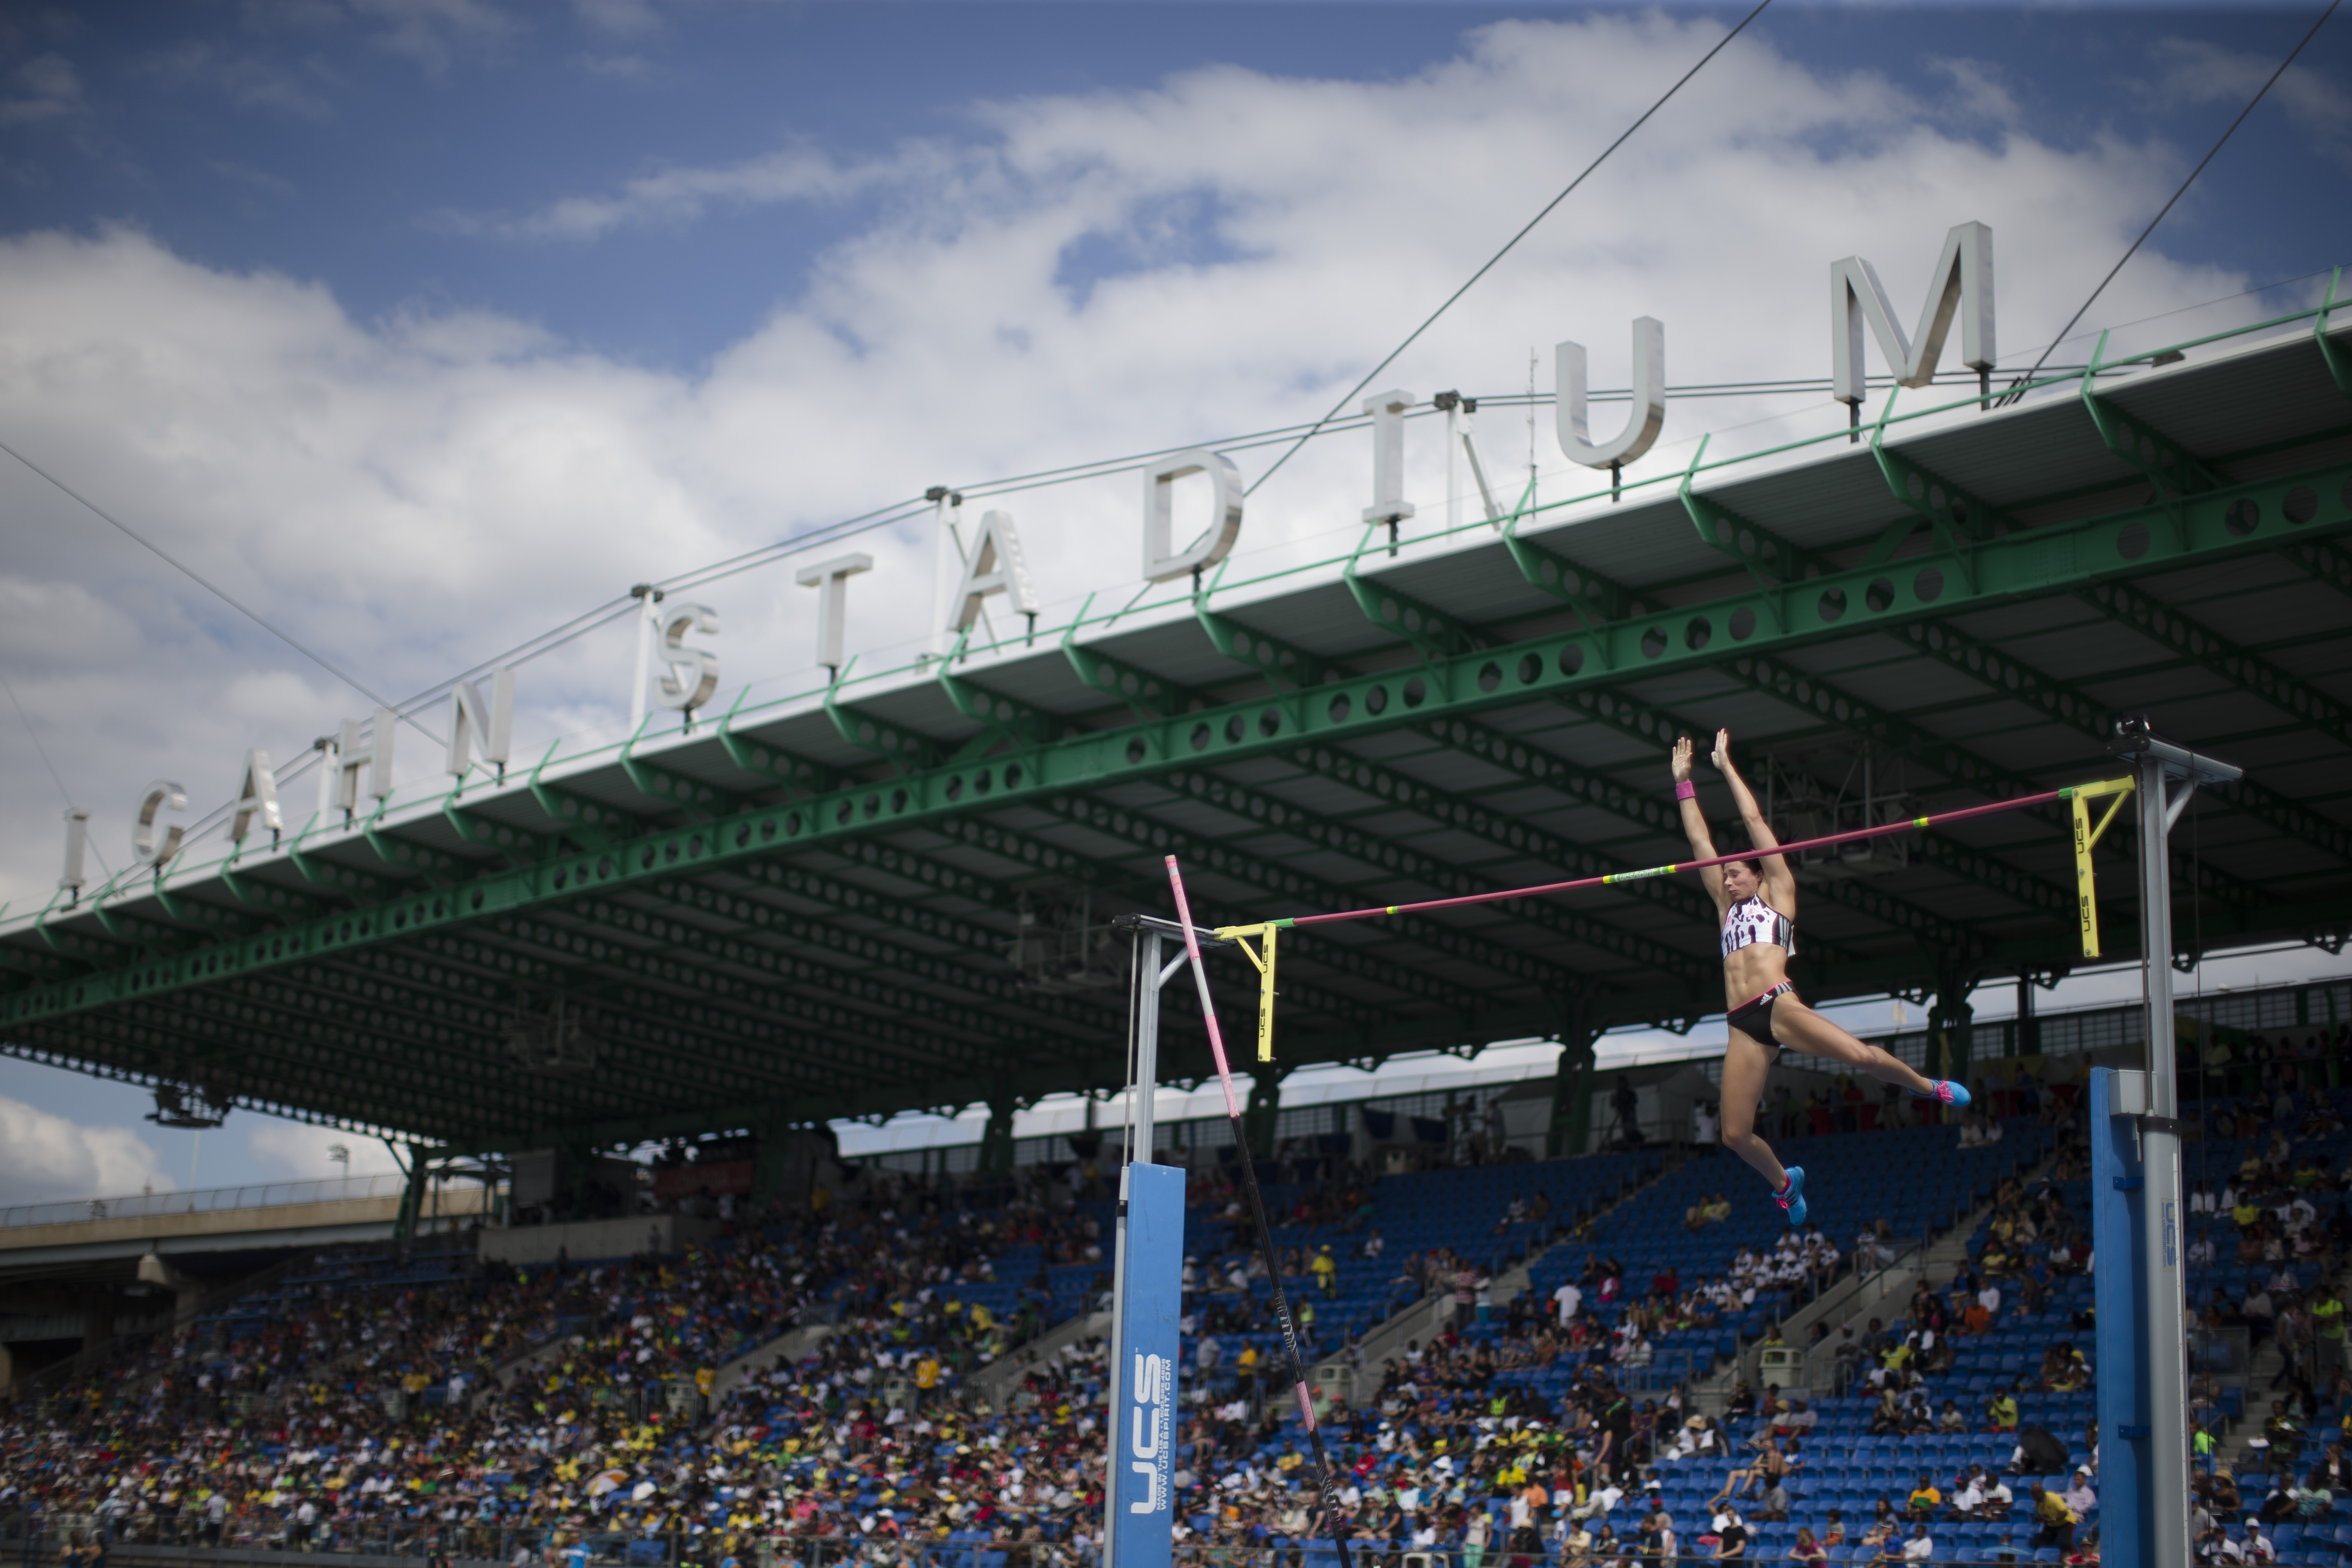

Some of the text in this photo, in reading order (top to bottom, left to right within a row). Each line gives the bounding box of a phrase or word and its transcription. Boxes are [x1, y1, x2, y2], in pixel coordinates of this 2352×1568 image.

[63, 220, 1996, 887] ICAHN STADIUM
[2076, 818, 2084, 854] UCS
[2081, 895, 2091, 932] UCS
[2166, 1203, 2176, 1266] UCS
[1131, 1354, 1161, 1514] UCS
[1157, 1474, 1162, 1482] IN
